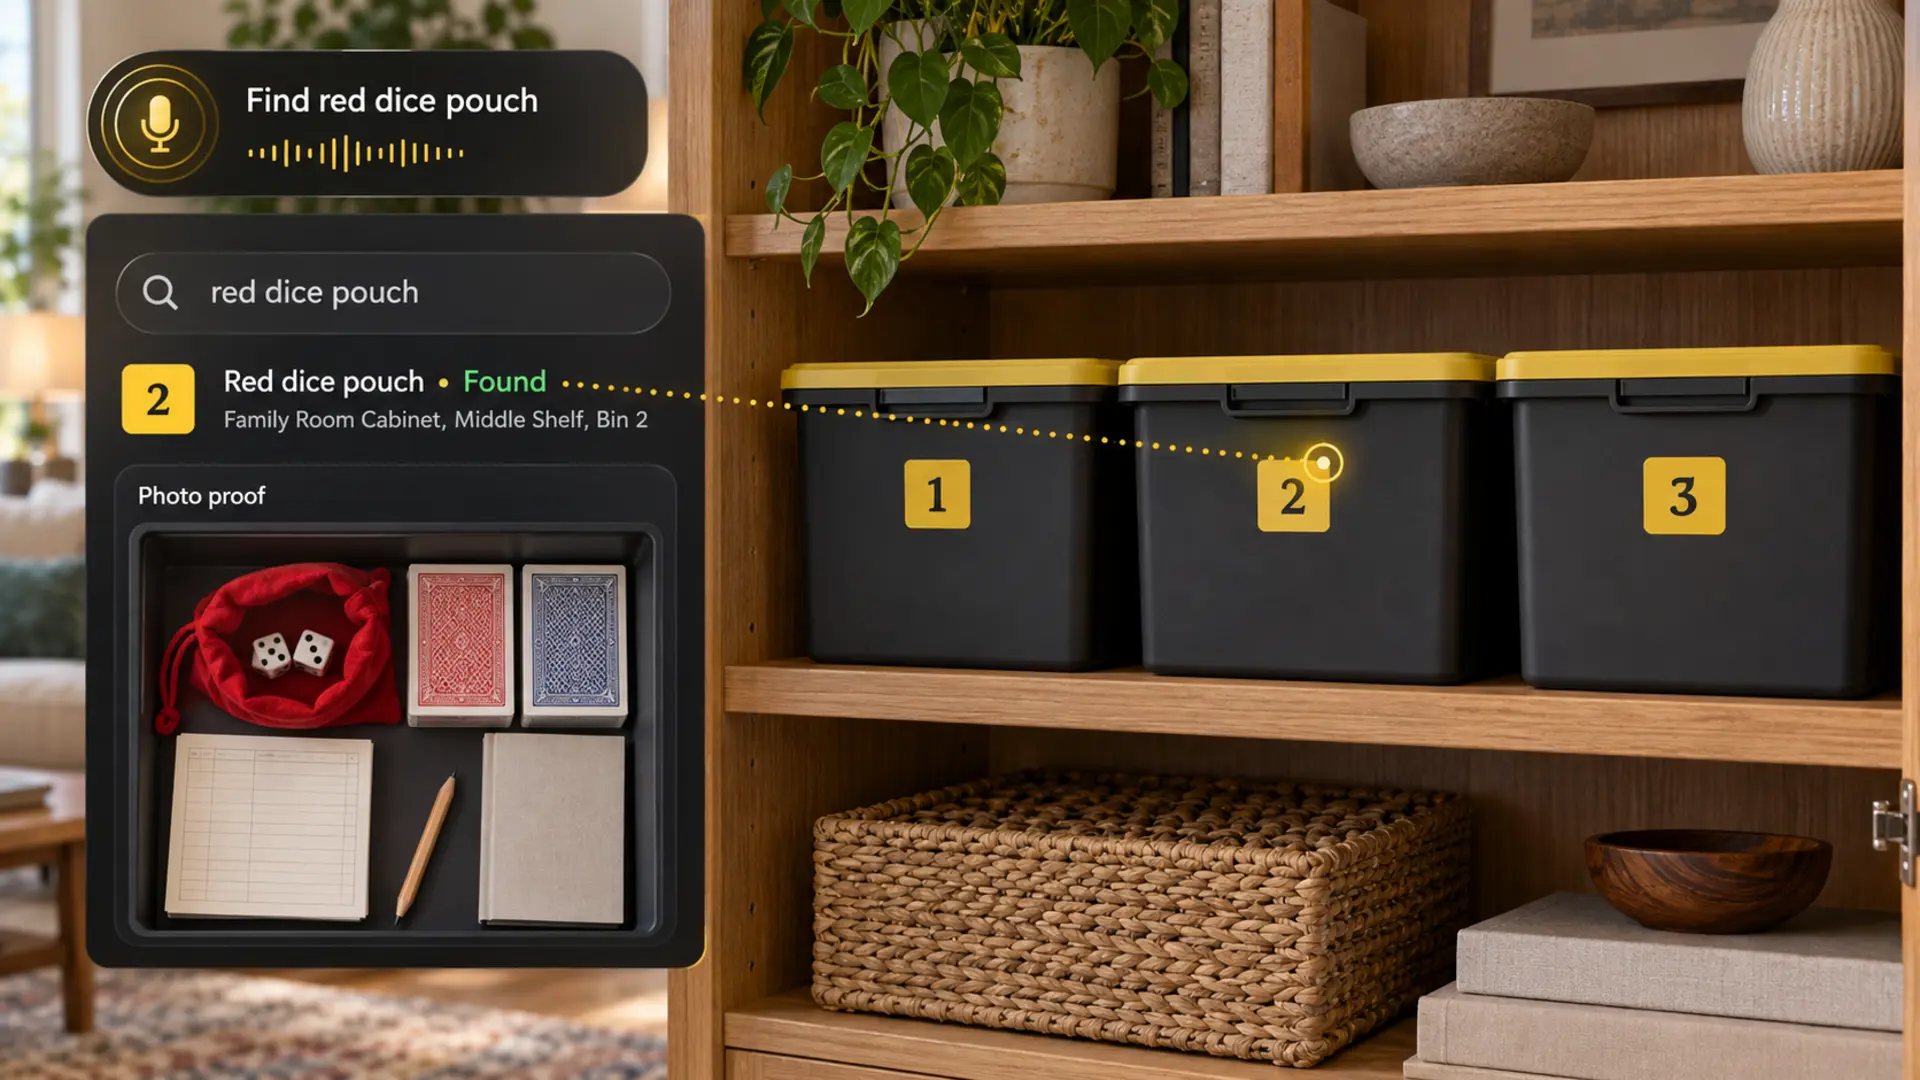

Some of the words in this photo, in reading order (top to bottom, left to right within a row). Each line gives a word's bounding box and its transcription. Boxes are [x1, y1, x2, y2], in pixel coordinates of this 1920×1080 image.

[927, 476, 948, 513] 1
[1280, 478, 1306, 515] 2
[1669, 476, 1698, 517] 3
